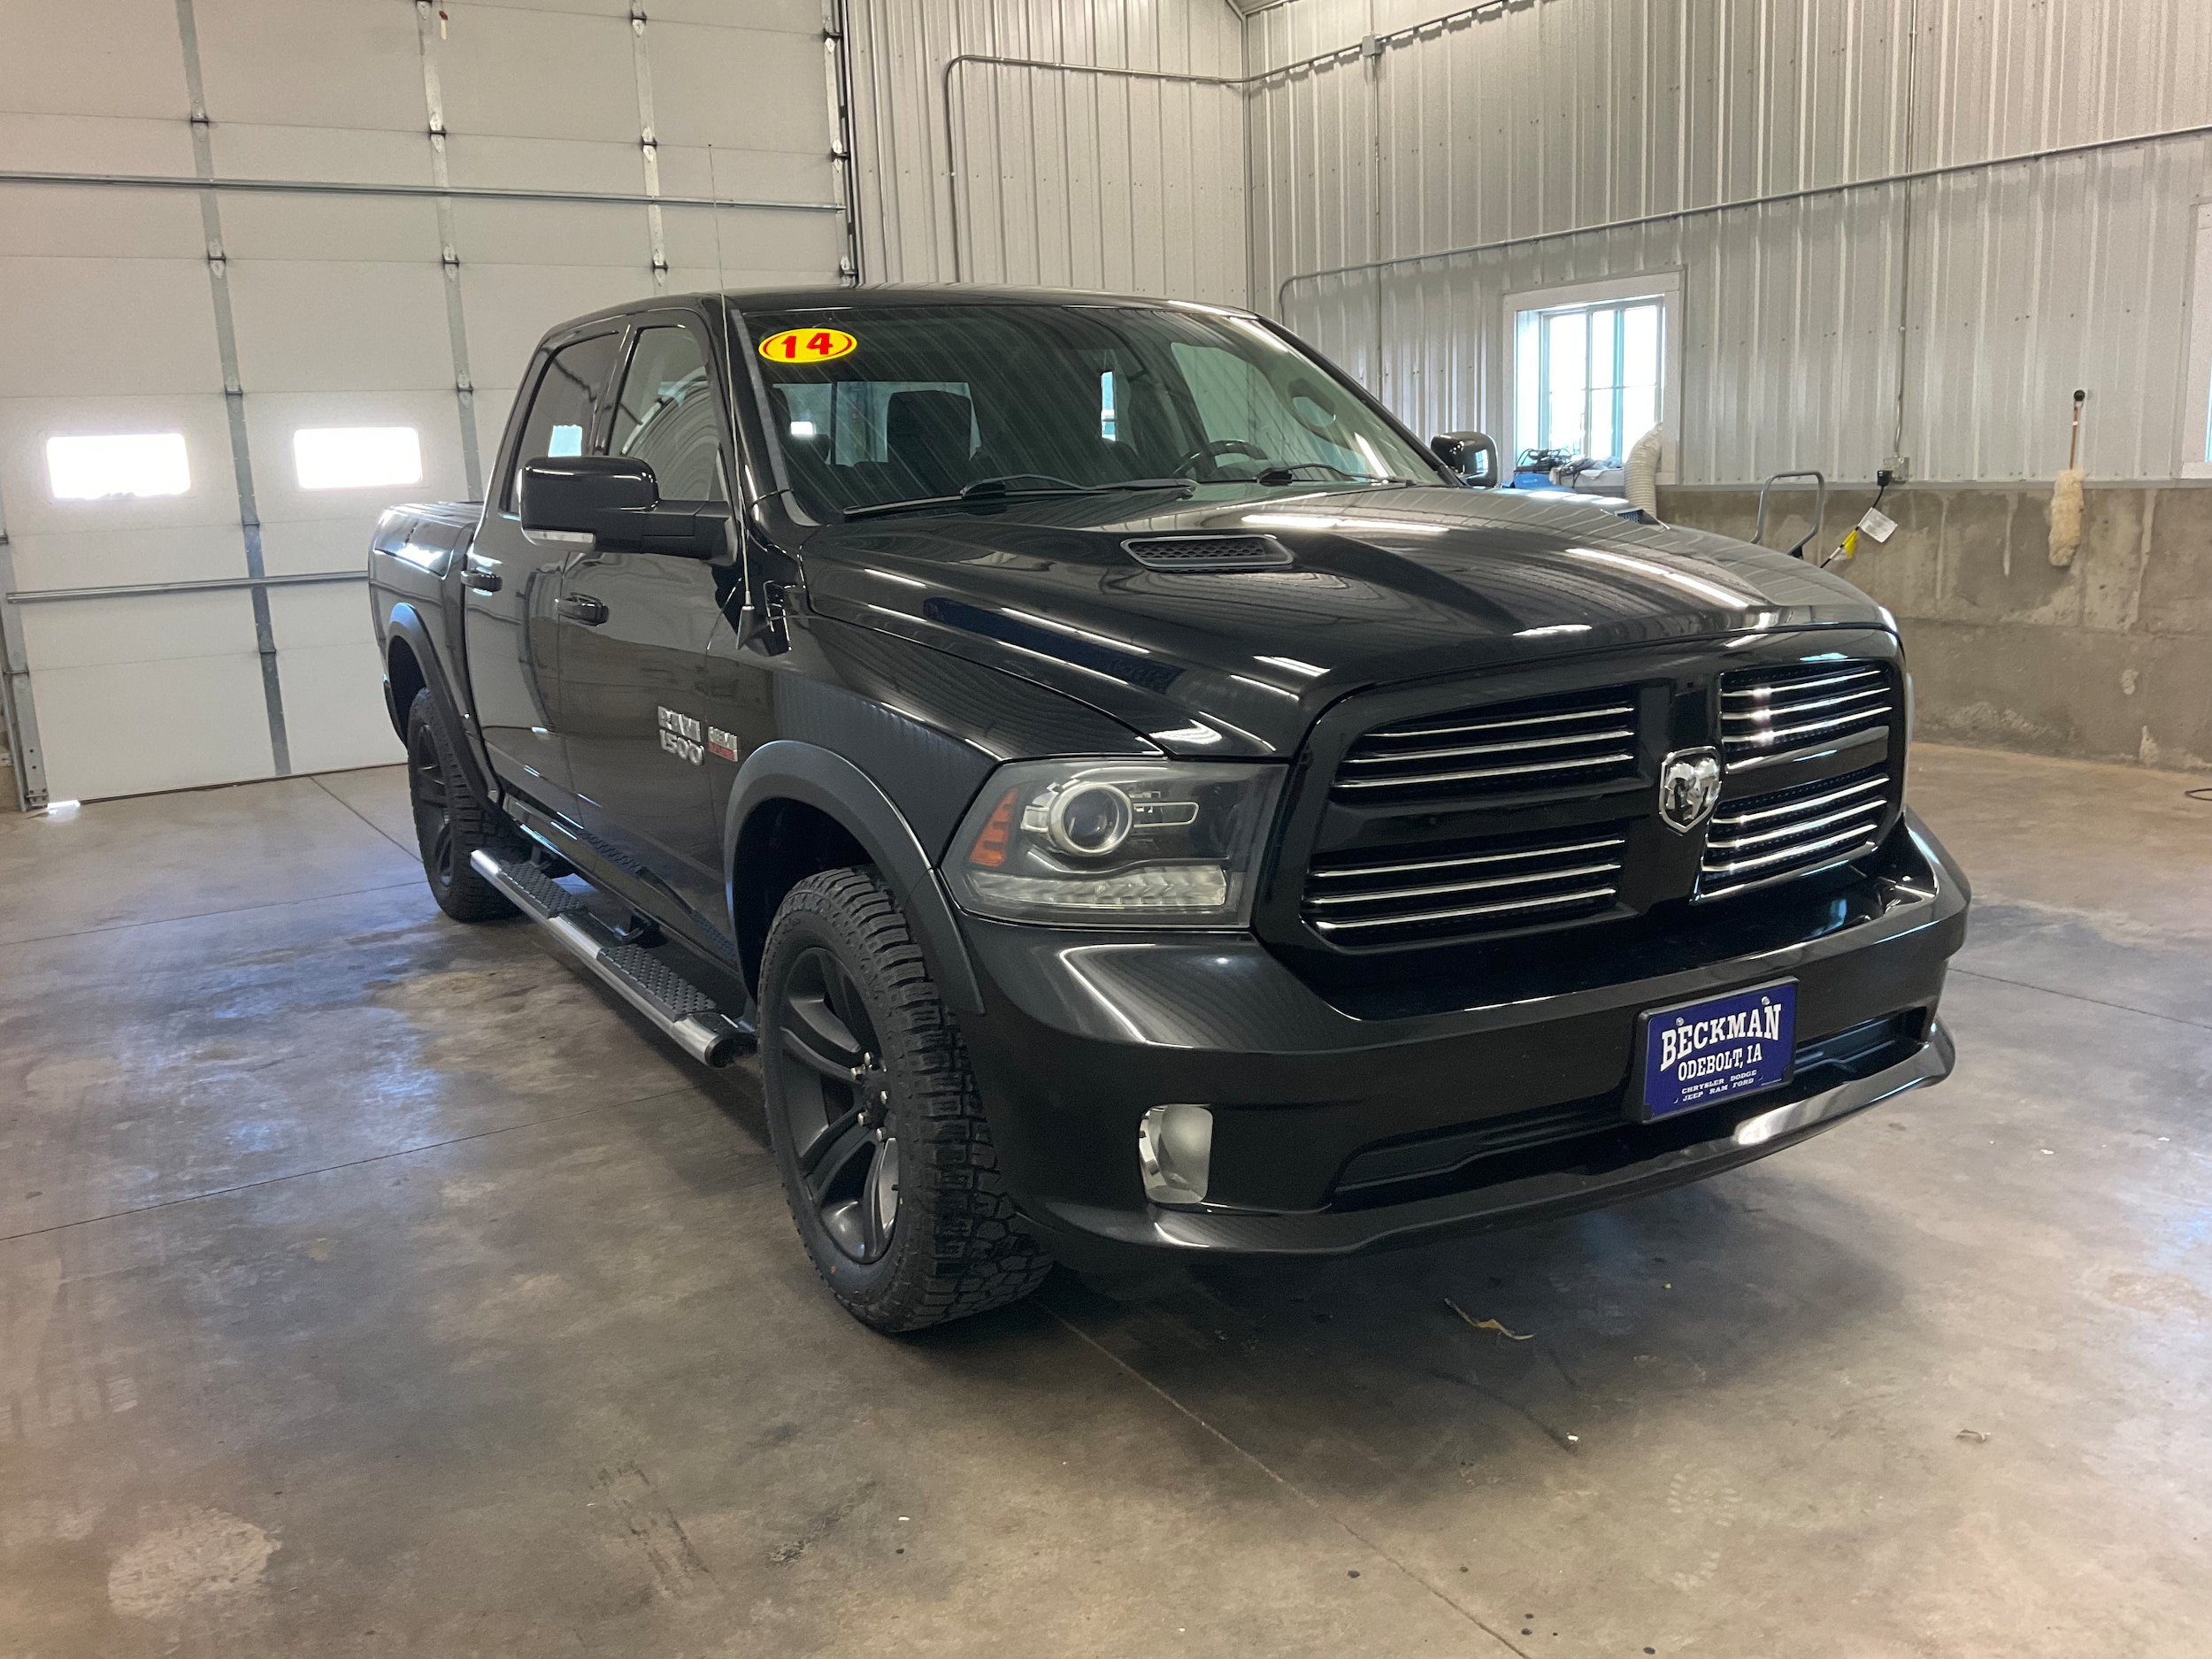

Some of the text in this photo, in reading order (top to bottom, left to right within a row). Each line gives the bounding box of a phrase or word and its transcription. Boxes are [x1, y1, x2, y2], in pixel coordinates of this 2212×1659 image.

[781, 333, 833, 358] 14
[659, 728, 704, 766] 1500
[1660, 1003, 1782, 1072] BECKMAN
[1678, 1043, 1763, 1081] ODEBOLT, IA
[1681, 1069, 1757, 1094] CHRYSLER DODGE
[1682, 1078, 1755, 1102] JEEP RAM FORD
